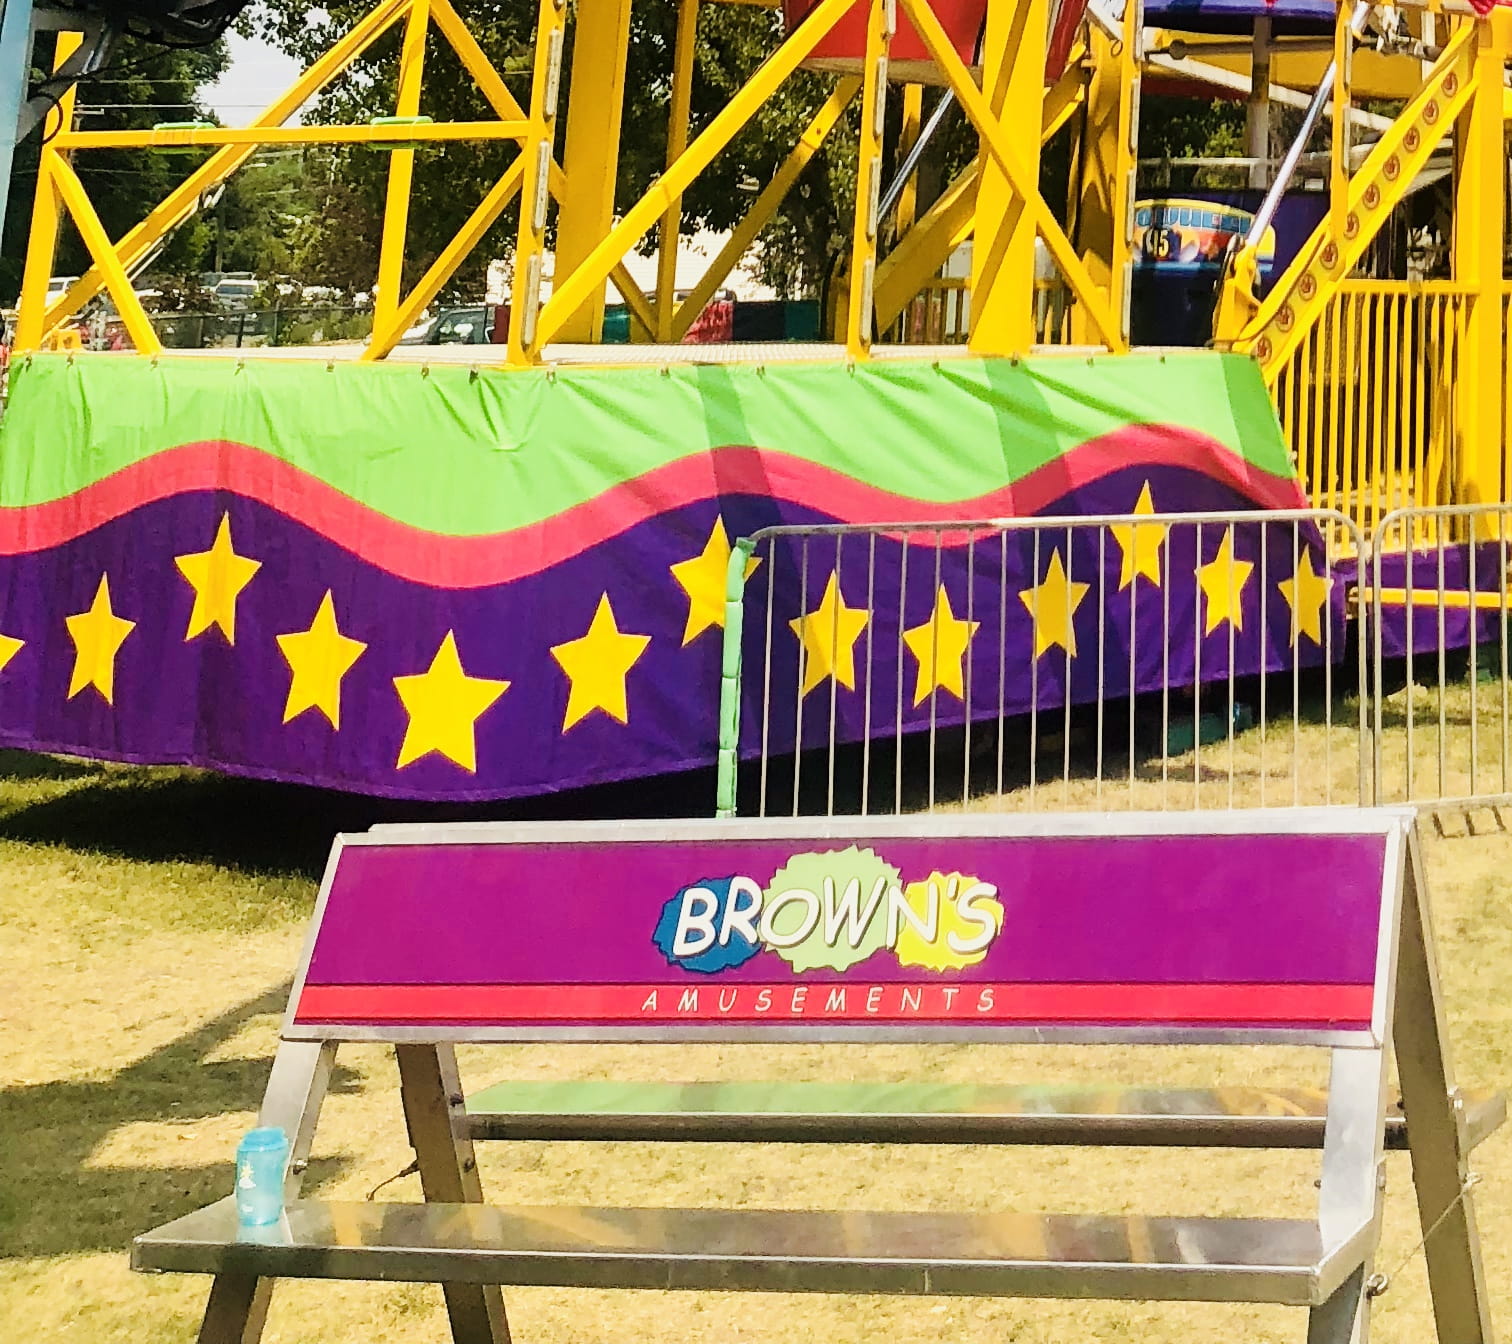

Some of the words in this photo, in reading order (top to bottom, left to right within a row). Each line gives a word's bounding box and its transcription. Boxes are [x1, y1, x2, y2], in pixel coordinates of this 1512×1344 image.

[1153, 229, 1170, 257] 15
[671, 875, 999, 957] BROWN'S
[641, 986, 996, 1014] AMUSEMENTS
